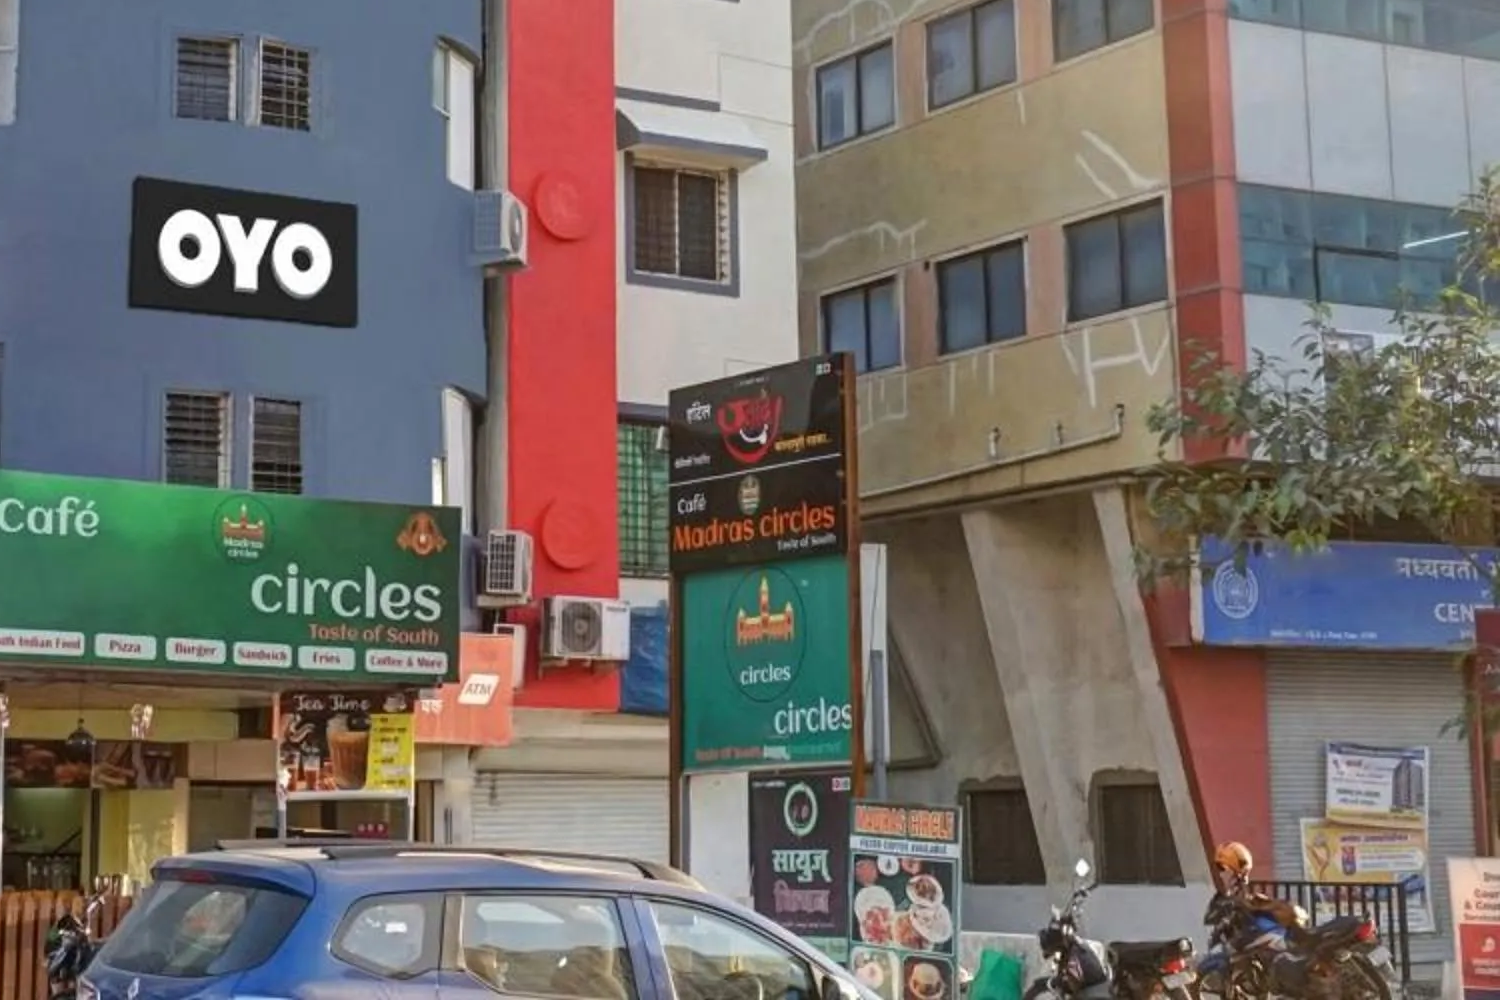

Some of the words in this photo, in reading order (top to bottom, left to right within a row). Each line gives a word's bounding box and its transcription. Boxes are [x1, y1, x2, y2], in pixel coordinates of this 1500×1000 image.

[158, 209, 333, 299] OYO
[677, 493, 707, 514] Café
[674, 517, 755, 551] Madras
[760, 501, 835, 538] circles
[251, 563, 442, 623] circles
[1434, 603, 1494, 624] CEN
[309, 623, 358, 641] Taste
[363, 624, 382, 643] of
[387, 626, 439, 645] South
[109, 639, 141, 654] Pizza
[174, 642, 217, 658] Burger
[740, 663, 791, 685] circles
[774, 697, 852, 735] circles
